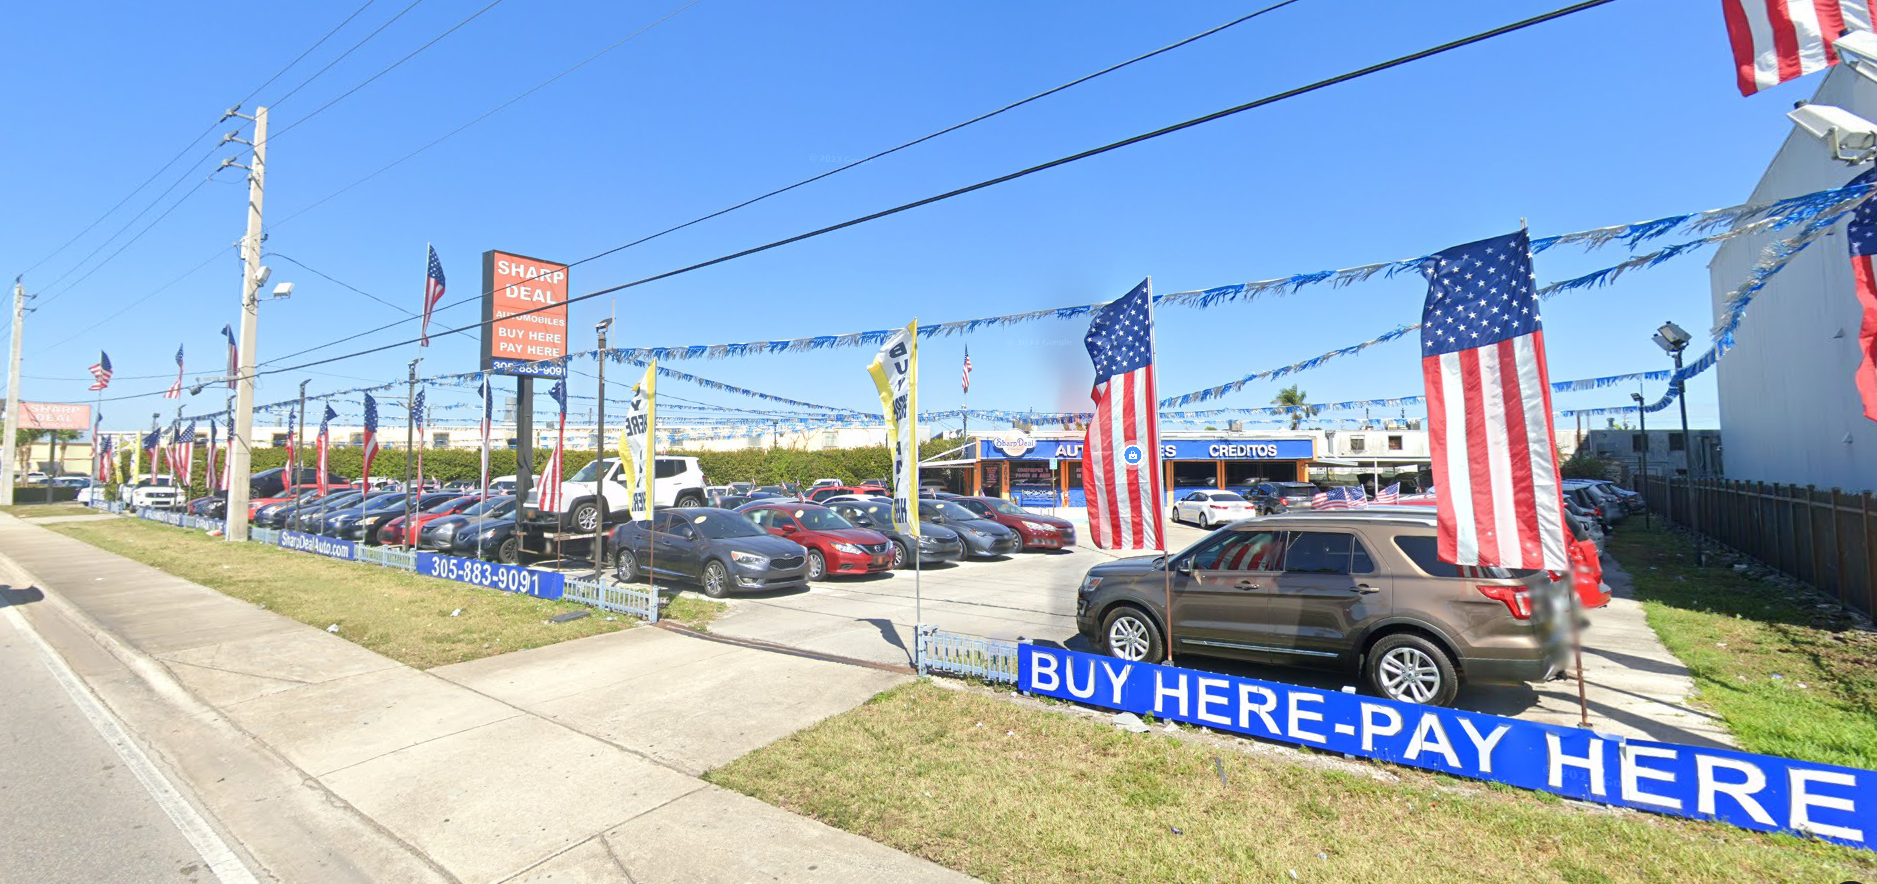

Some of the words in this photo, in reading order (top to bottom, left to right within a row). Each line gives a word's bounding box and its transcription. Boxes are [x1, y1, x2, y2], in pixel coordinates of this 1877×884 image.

[497, 260, 565, 284] SHARP
[505, 283, 557, 305] DEAL
[495, 310, 566, 327] AUTOMOBILES
[498, 327, 525, 339] BUY
[528, 331, 562, 344] HERE
[499, 341, 524, 353] PAY
[527, 345, 560, 357] HERE
[493, 361, 566, 377] 305883-9091
[30, 404, 80, 414] SHARP
[36, 413, 72, 422] DEAL
[1209, 444, 1278, 458] CREDITOS
[281, 531, 349, 558] SharpDealAuto.com
[431, 555, 540, 595] 305-883-9091
[1031, 650, 1134, 704] BUY
[1154, 670, 1511, 773] HERE-PAY
[1546, 731, 1866, 842] HERE
